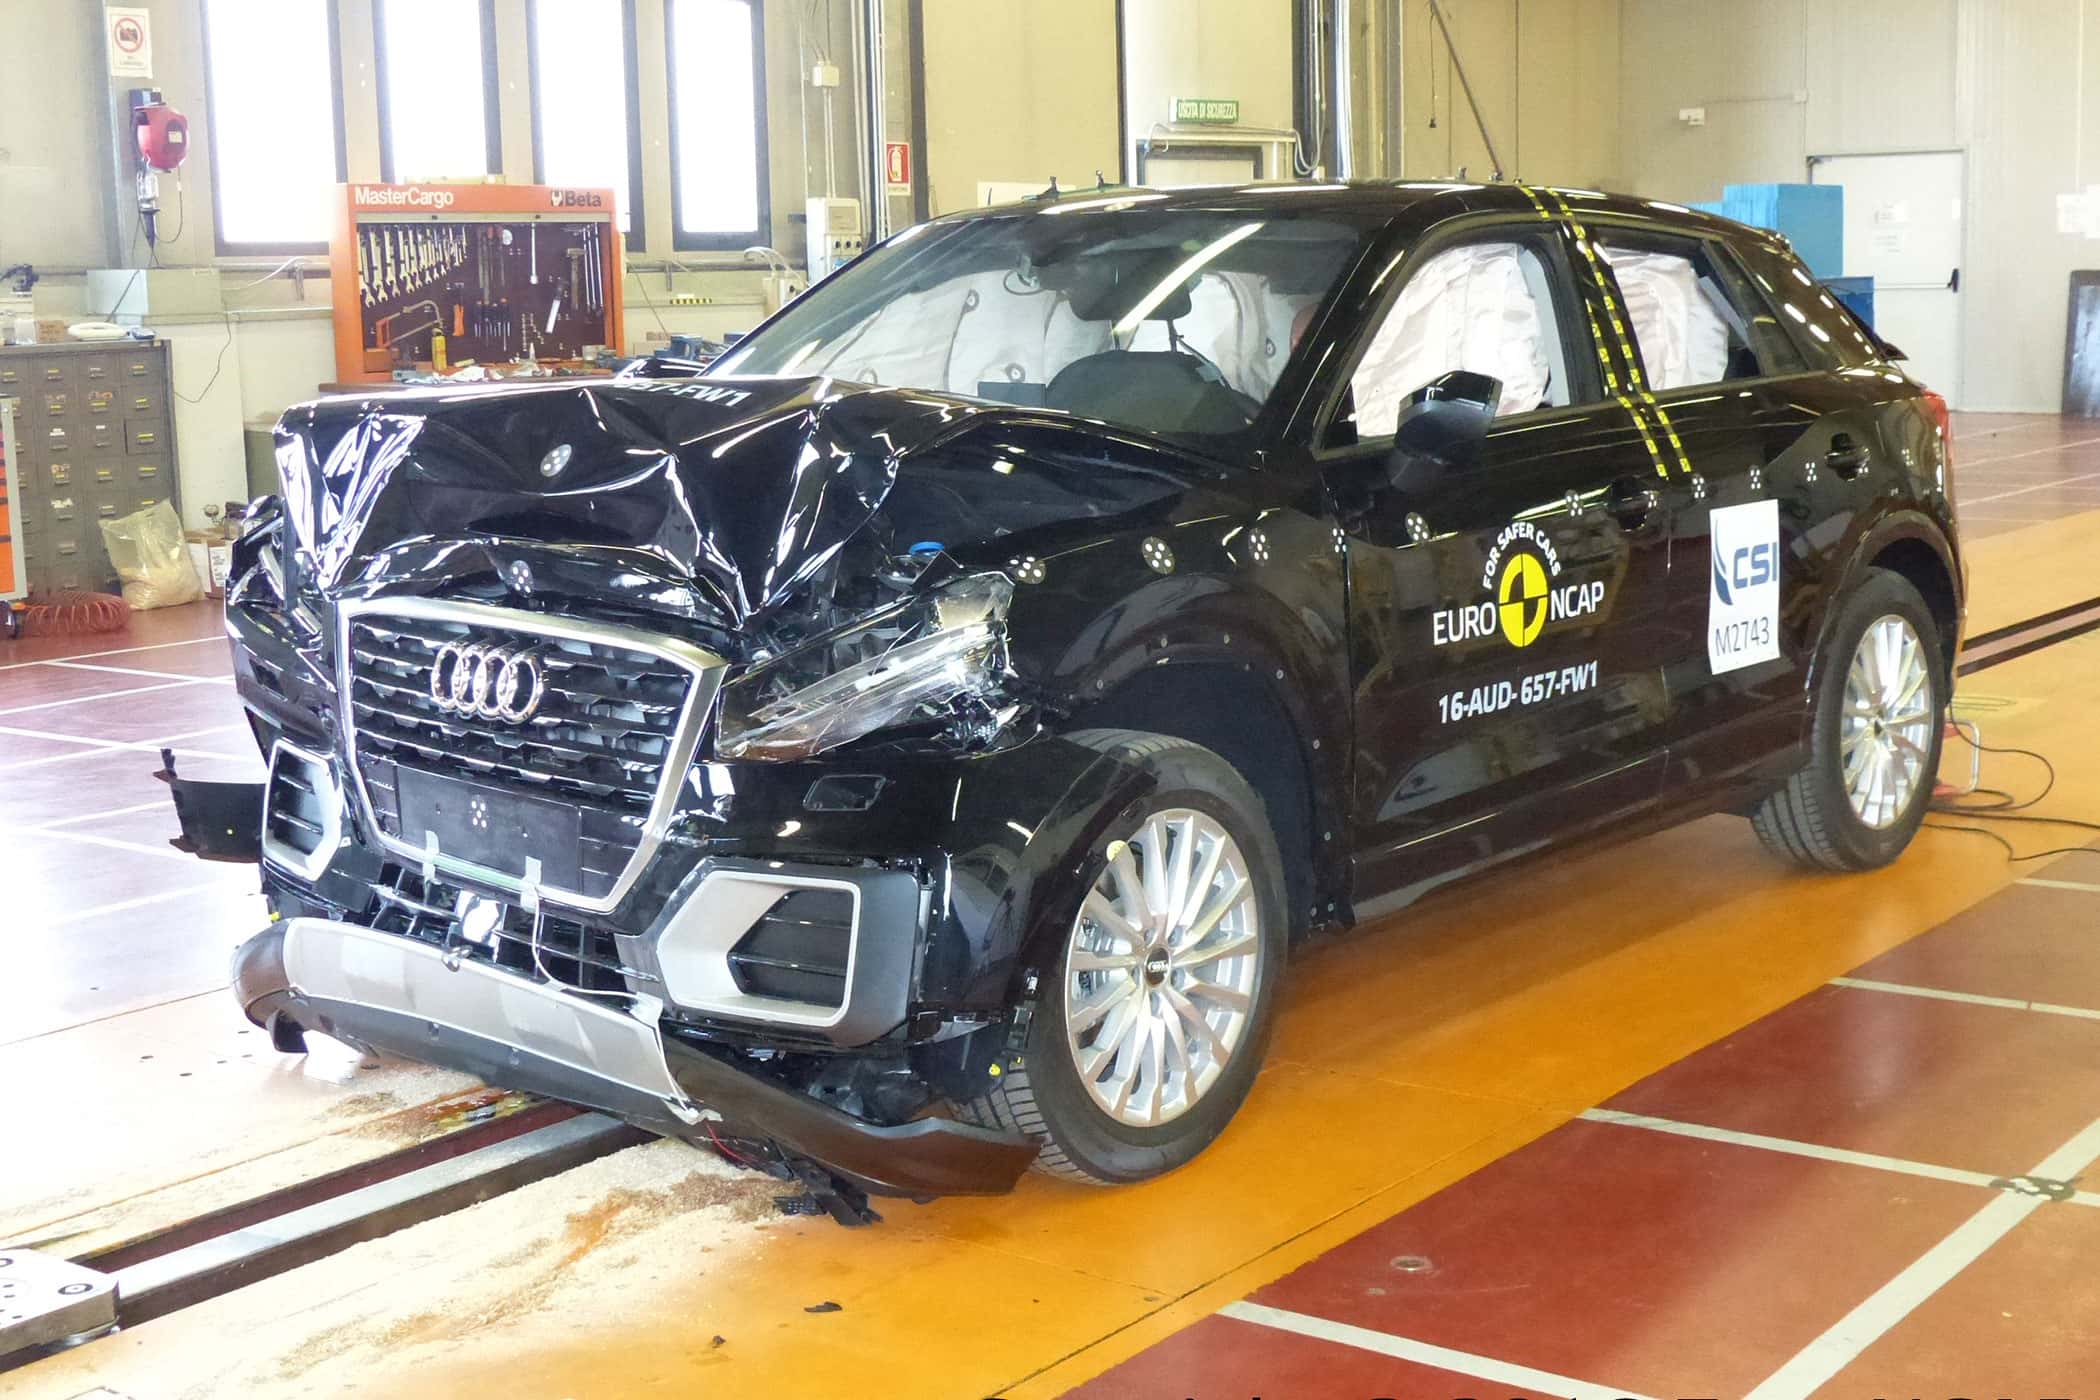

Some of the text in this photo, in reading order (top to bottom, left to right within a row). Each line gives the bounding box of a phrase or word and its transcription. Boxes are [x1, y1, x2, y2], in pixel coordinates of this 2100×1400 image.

[354, 186, 454, 209] MasterCargo
[565, 190, 602, 207] Beta
[1482, 521, 1561, 590] FOR SAFER CARS
[1733, 541, 1778, 589] CSI
[1433, 581, 1605, 646] EURO NCAP
[1715, 616, 1770, 656] M2743
